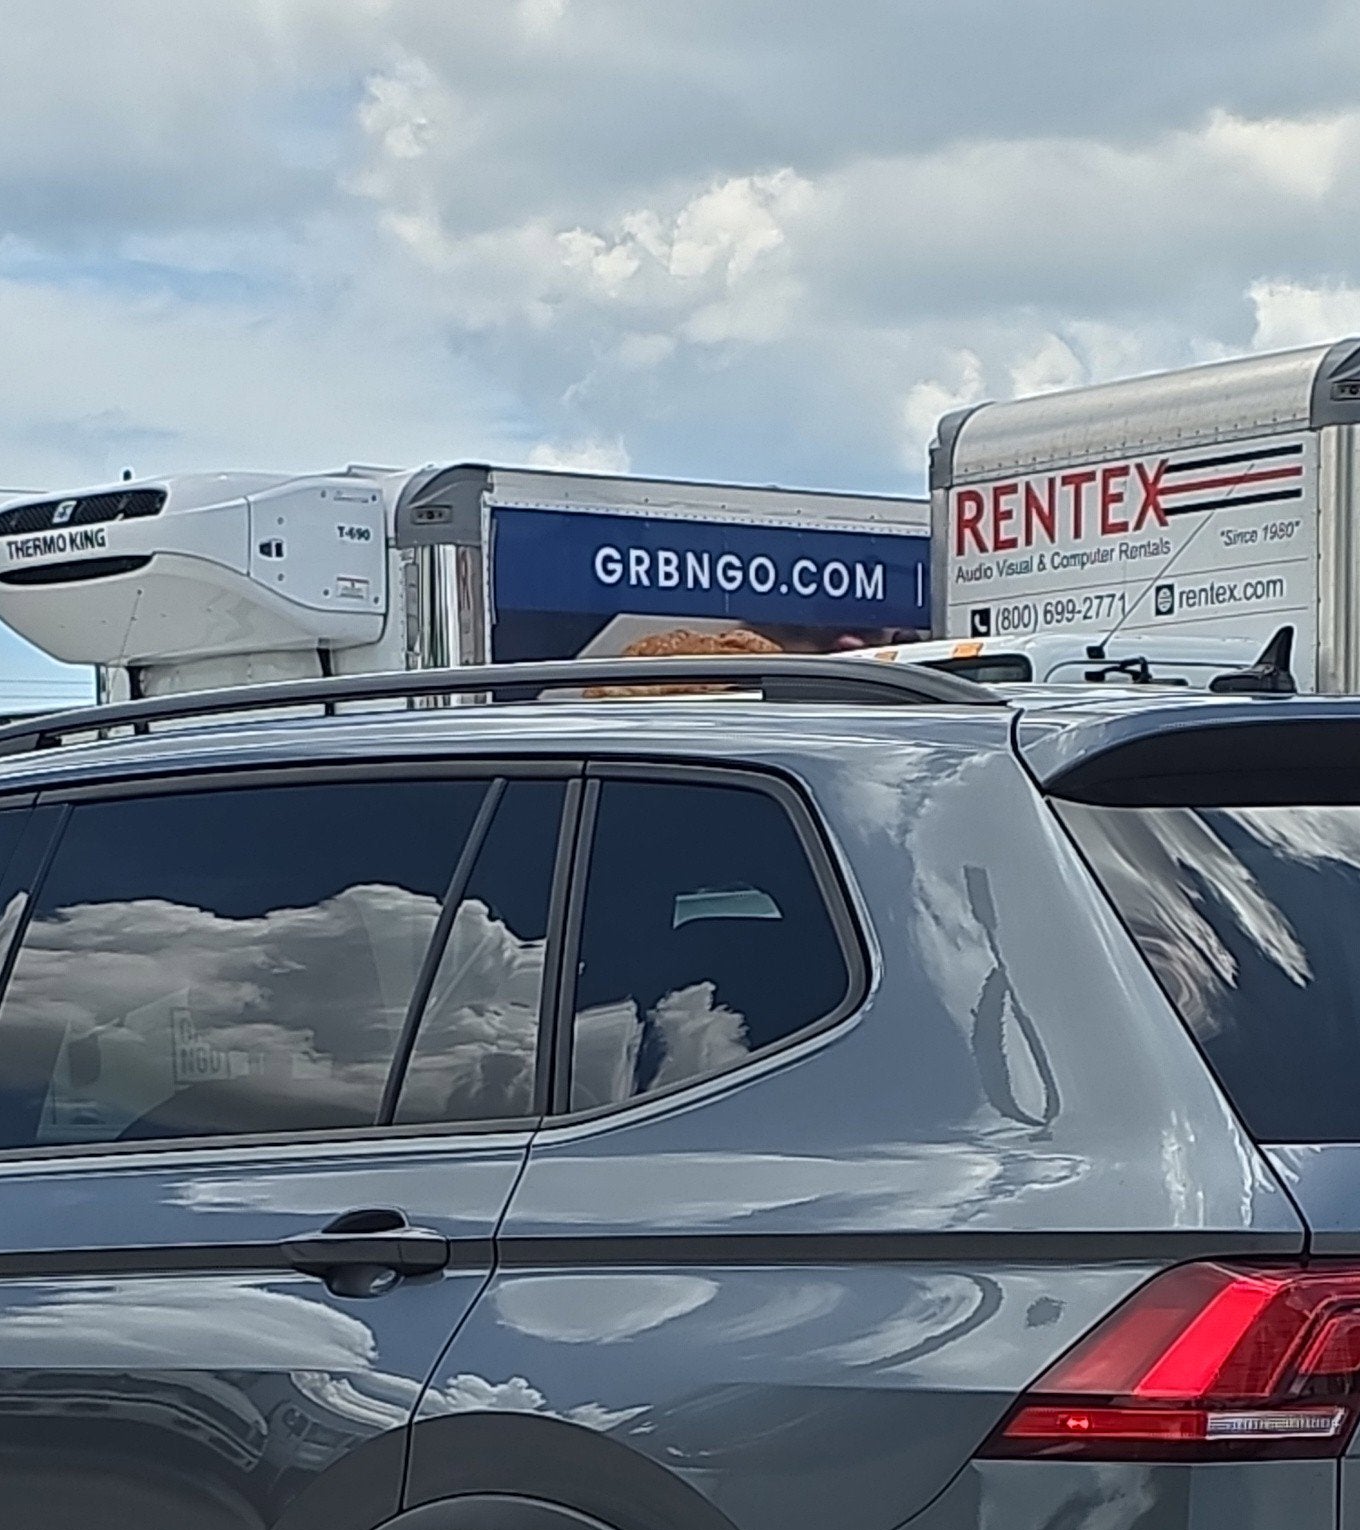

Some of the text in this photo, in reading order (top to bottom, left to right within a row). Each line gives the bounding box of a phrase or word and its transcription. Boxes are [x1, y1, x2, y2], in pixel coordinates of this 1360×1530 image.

[956, 458, 1169, 557] RENTEX
[6, 528, 106, 560] THERMO KING
[955, 537, 1171, 584] Audio Visual & Computer Rentals
[594, 546, 884, 600] GRBNGO.COM
[1179, 577, 1284, 609] rentex.com
[995, 591, 1127, 635] (800) 699-2771
